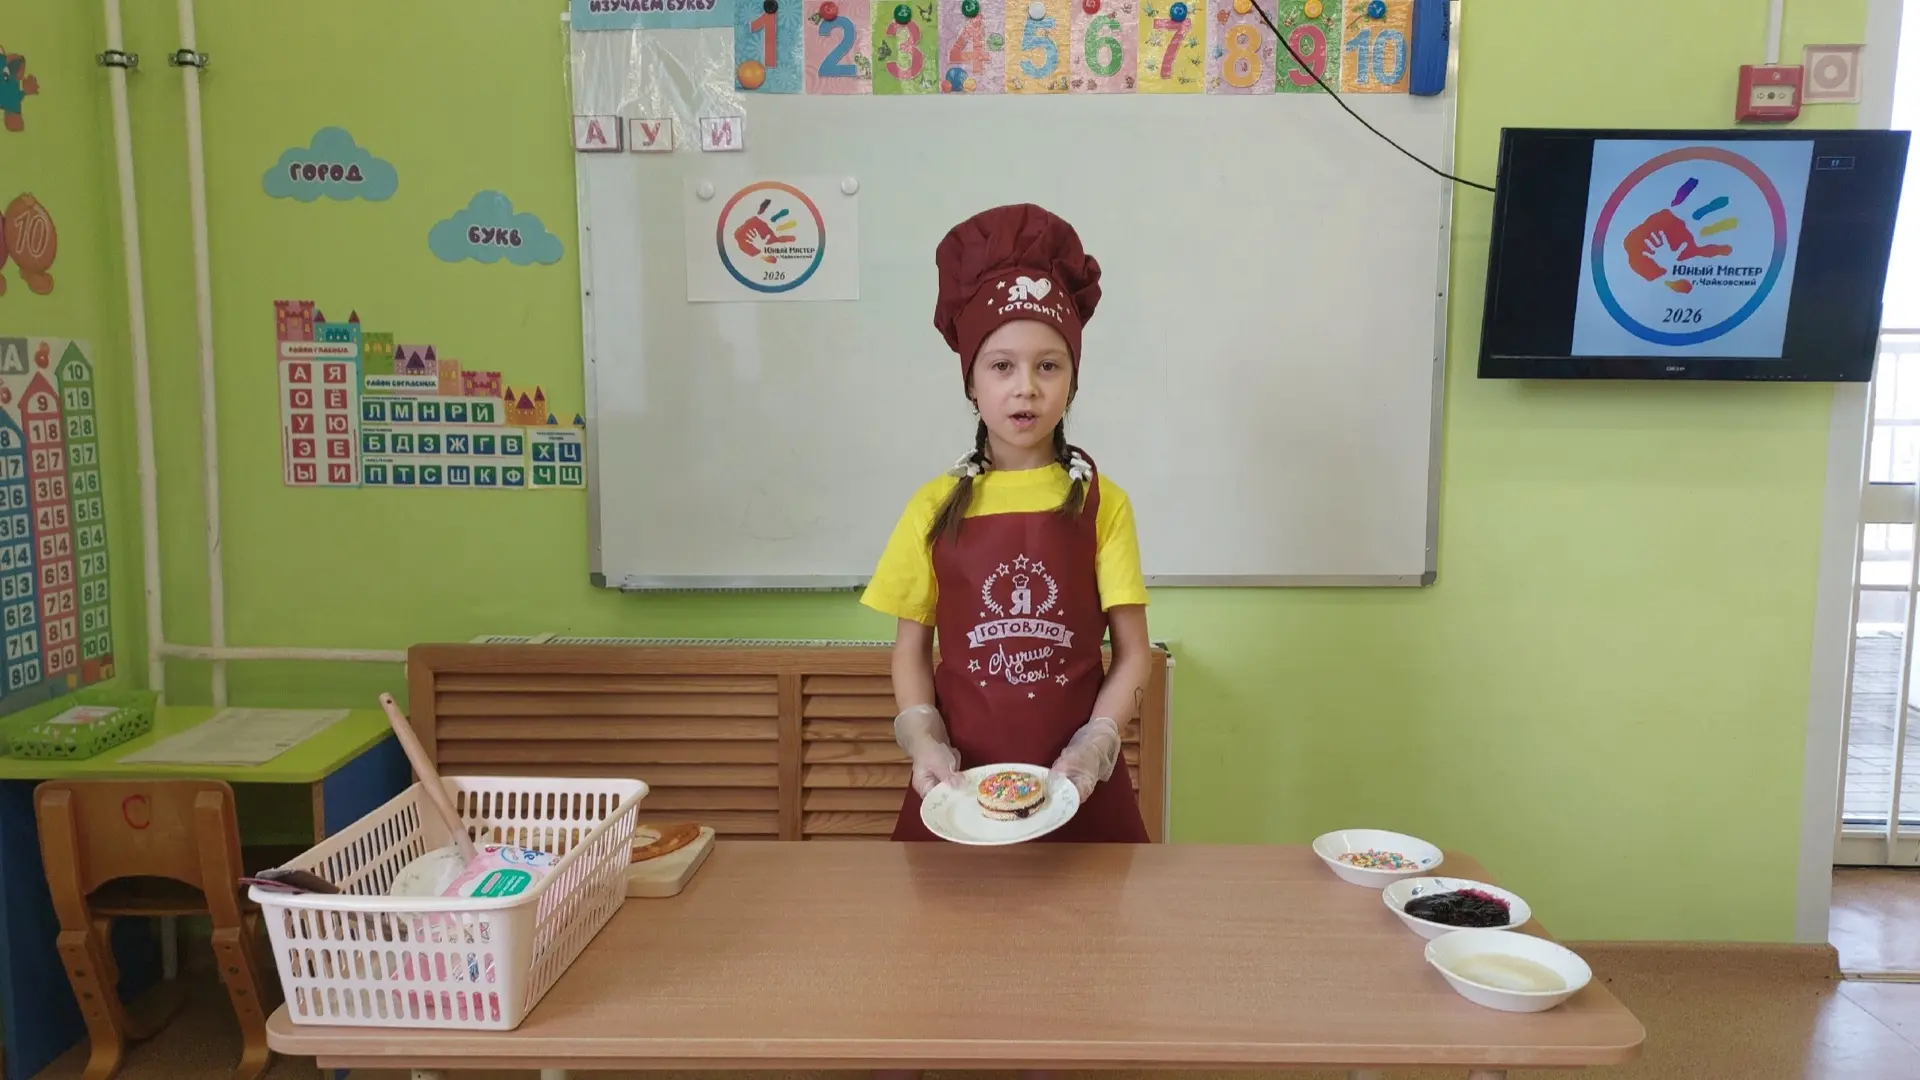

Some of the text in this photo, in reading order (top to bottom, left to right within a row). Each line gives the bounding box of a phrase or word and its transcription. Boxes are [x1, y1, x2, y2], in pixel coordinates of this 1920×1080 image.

[590, 0, 716, 12] ИЗУЧАЕМ БУКВУ
[751, 10, 1406, 88] 1 2 3 4 5 6 7 8 9 10
[586, 119, 733, 147] А У И
[289, 163, 364, 182] ГОРОД
[14, 211, 48, 257] 10
[468, 226, 522, 247] БУКВ
[763, 271, 786, 280] 2026
[1007, 285, 1027, 301] Я
[1662, 308, 1703, 323] 2026
[68, 364, 83, 380] 10
[294, 366, 341, 380] А Я
[38, 396, 48, 411] 9
[295, 389, 342, 407] О Ё
[369, 404, 488, 421] Л М Н Р Й
[297, 416, 346, 431] У Ю
[0, 431, 10, 447] 8
[369, 436, 518, 452] Б Д З Ж Г В
[300, 442, 345, 456] Э Е
[538, 444, 577, 460] Х Ц
[297, 465, 346, 480] Ы И
[370, 468, 521, 484] П Т С Ш К Ф
[539, 468, 580, 484] Ч Щ
[1009, 589, 1031, 615] Я
[980, 622, 1060, 638] ГОТОВЛЮ
[989, 644, 1054, 675] Лучше
[1005, 662, 1050, 685] всех!
